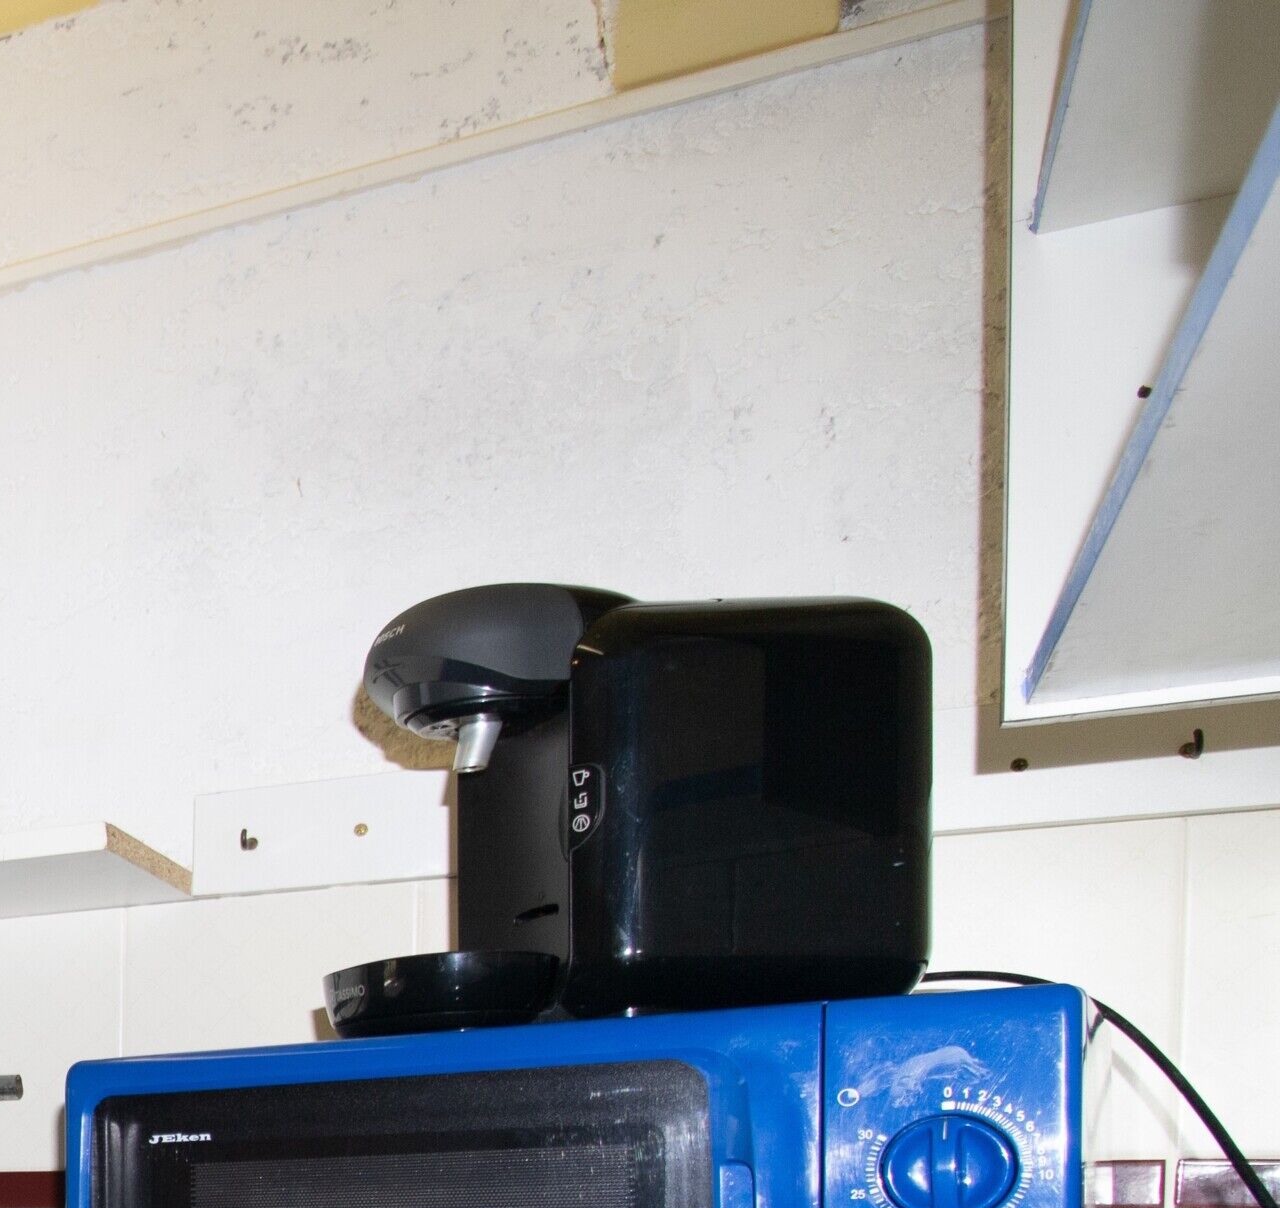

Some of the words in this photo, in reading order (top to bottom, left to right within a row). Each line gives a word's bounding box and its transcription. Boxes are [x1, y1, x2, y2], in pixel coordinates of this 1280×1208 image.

[943, 1086, 953, 1098] 0
[963, 1087, 970, 1099] 1
[978, 1090, 988, 1101] 2
[992, 1095, 1002, 1107] 3
[1004, 1102, 1013, 1114] 4
[1015, 1110, 1025, 1122] 5
[1025, 1120, 1035, 1132] 6
[148, 1132, 212, 1145] JEken
[857, 1129, 873, 1140] 30
[1039, 1168, 1054, 1180] 10
[850, 1189, 865, 1200] 25
